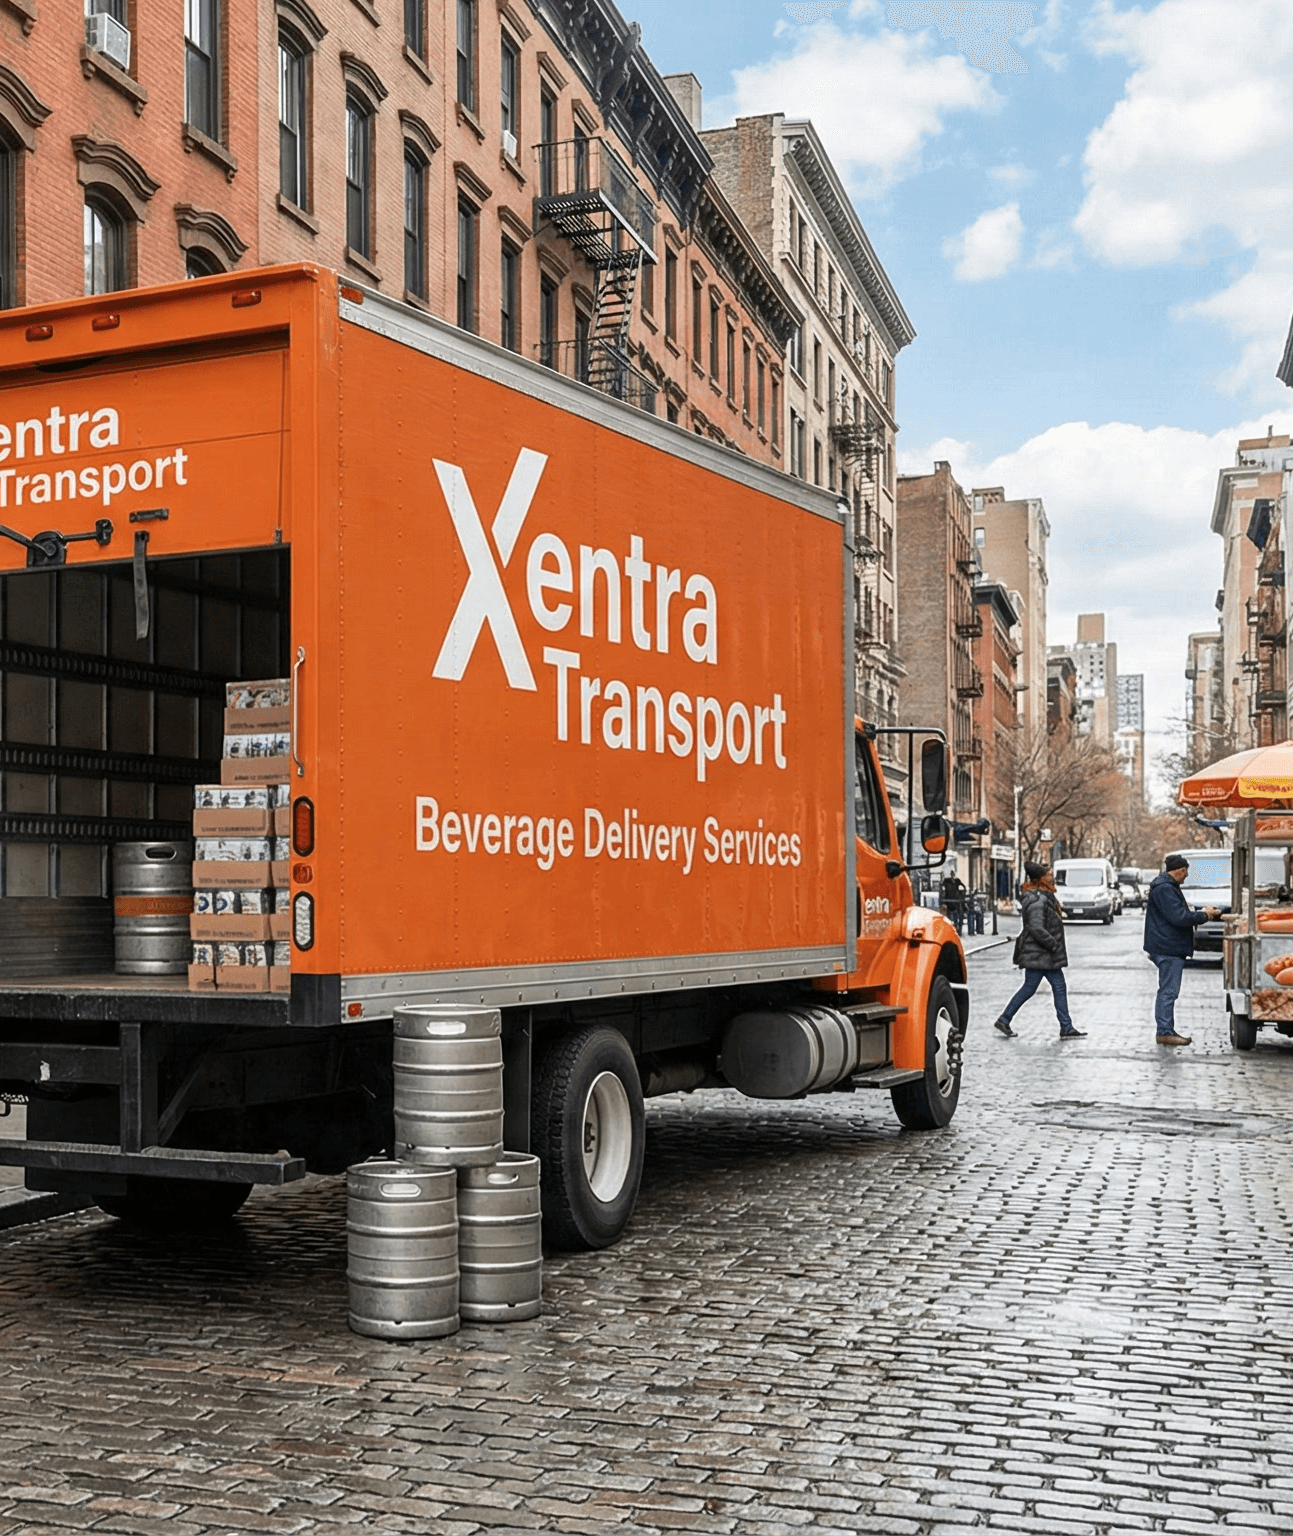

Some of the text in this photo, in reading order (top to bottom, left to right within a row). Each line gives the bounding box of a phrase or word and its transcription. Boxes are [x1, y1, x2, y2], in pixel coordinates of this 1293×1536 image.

[431, 447, 718, 692] Xentra
[542, 647, 787, 782] Transport
[415, 796, 802, 875] Beverage Delivery Services
